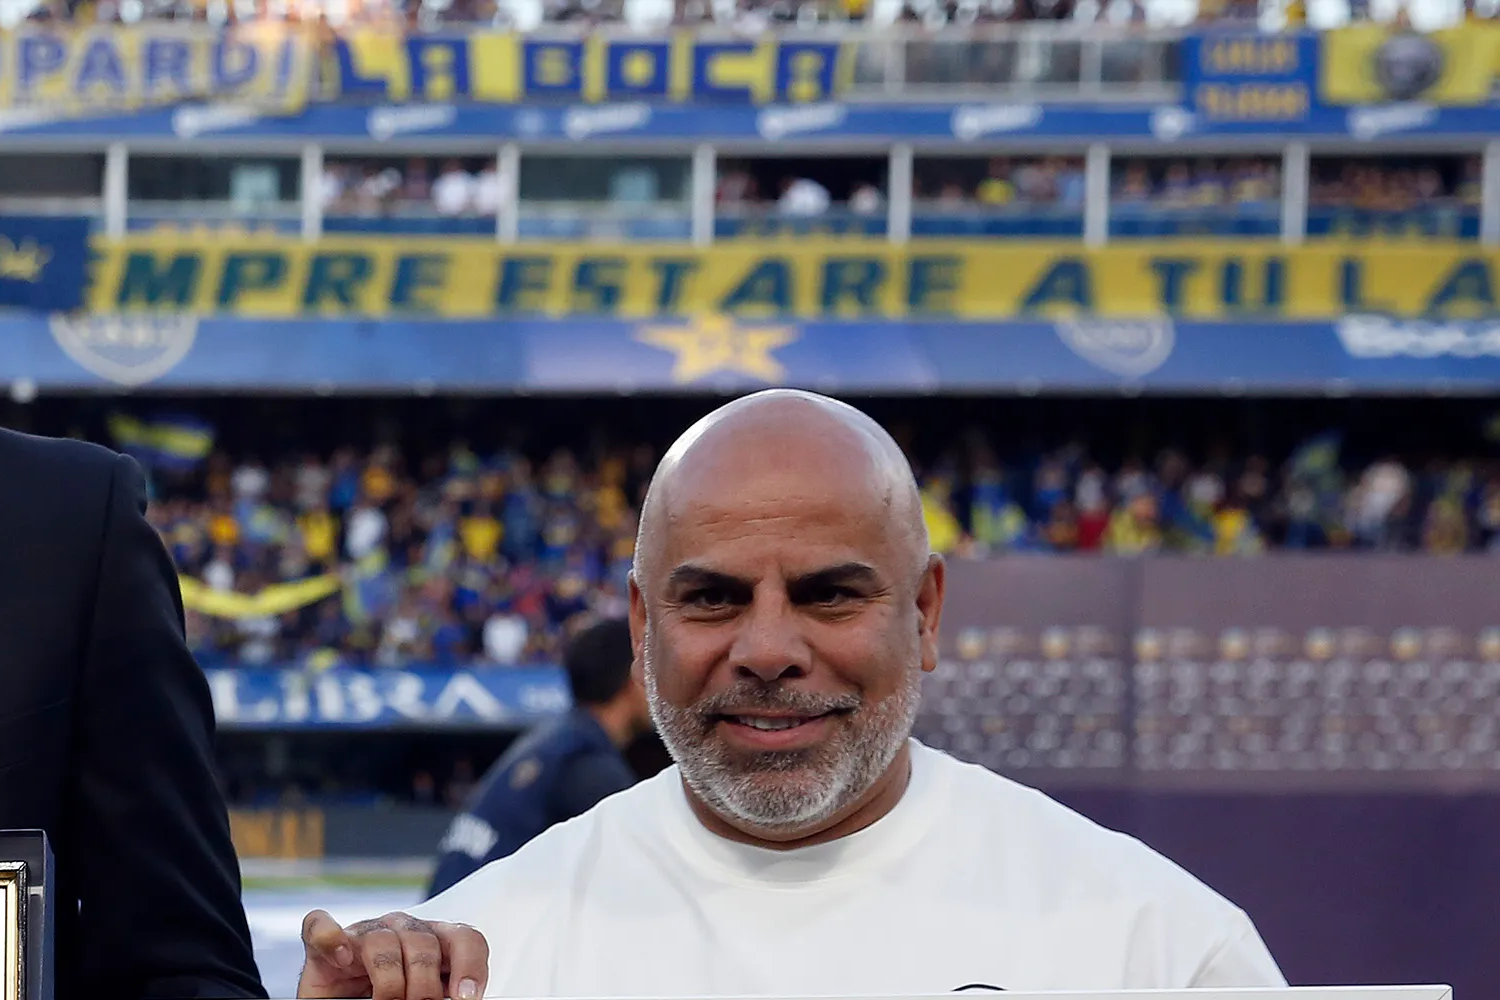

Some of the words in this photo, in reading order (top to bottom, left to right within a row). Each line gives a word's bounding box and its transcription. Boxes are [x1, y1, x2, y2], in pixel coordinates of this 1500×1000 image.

[87, 250, 455, 309] MPRE
[500, 252, 963, 316] ESTARE
[1020, 256, 1096, 318] A
[1148, 256, 1288, 318] TU
